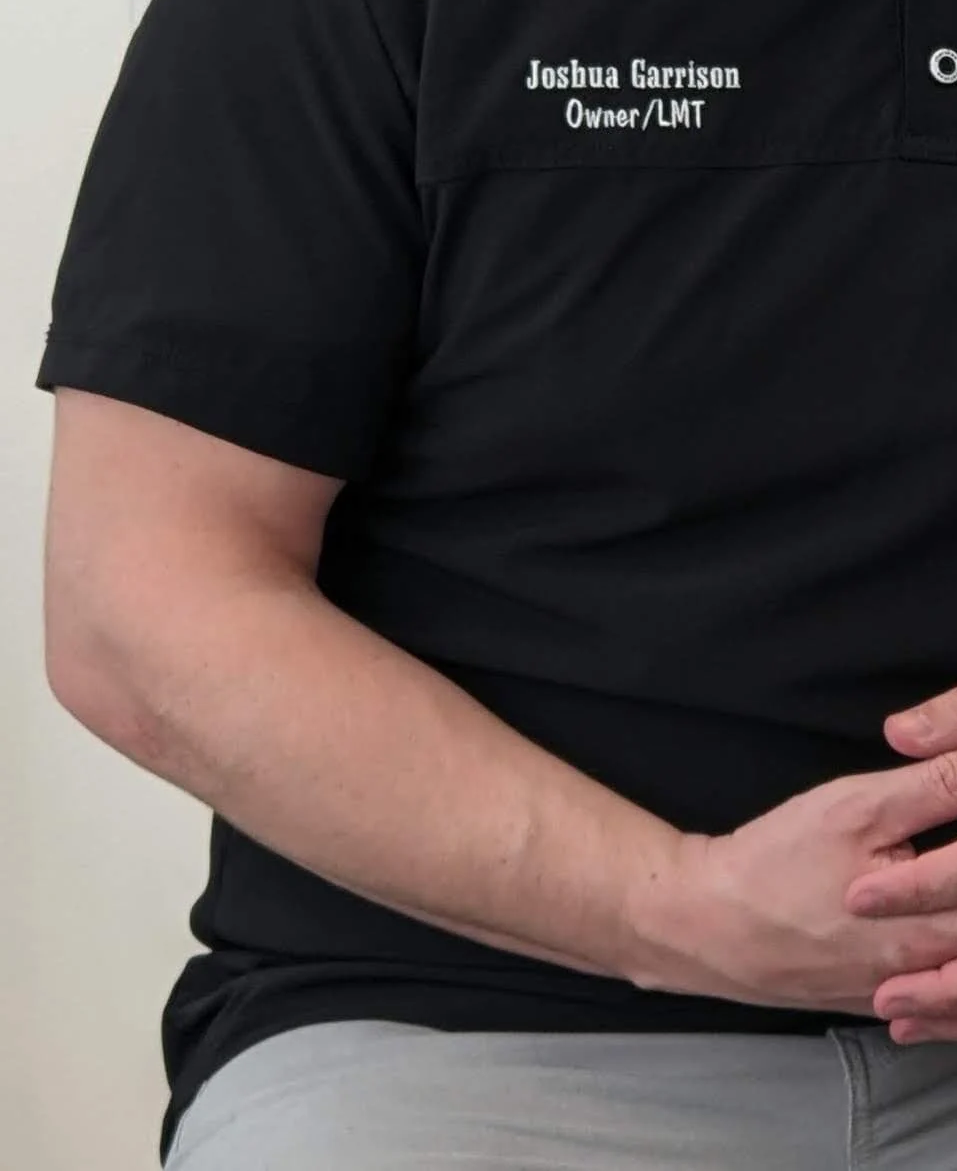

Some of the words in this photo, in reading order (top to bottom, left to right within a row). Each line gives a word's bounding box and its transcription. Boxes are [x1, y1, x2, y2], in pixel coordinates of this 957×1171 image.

[526, 59, 620, 90] Joshua
[630, 58, 742, 90] Garrison
[565, 97, 706, 131] Owner/LMT
